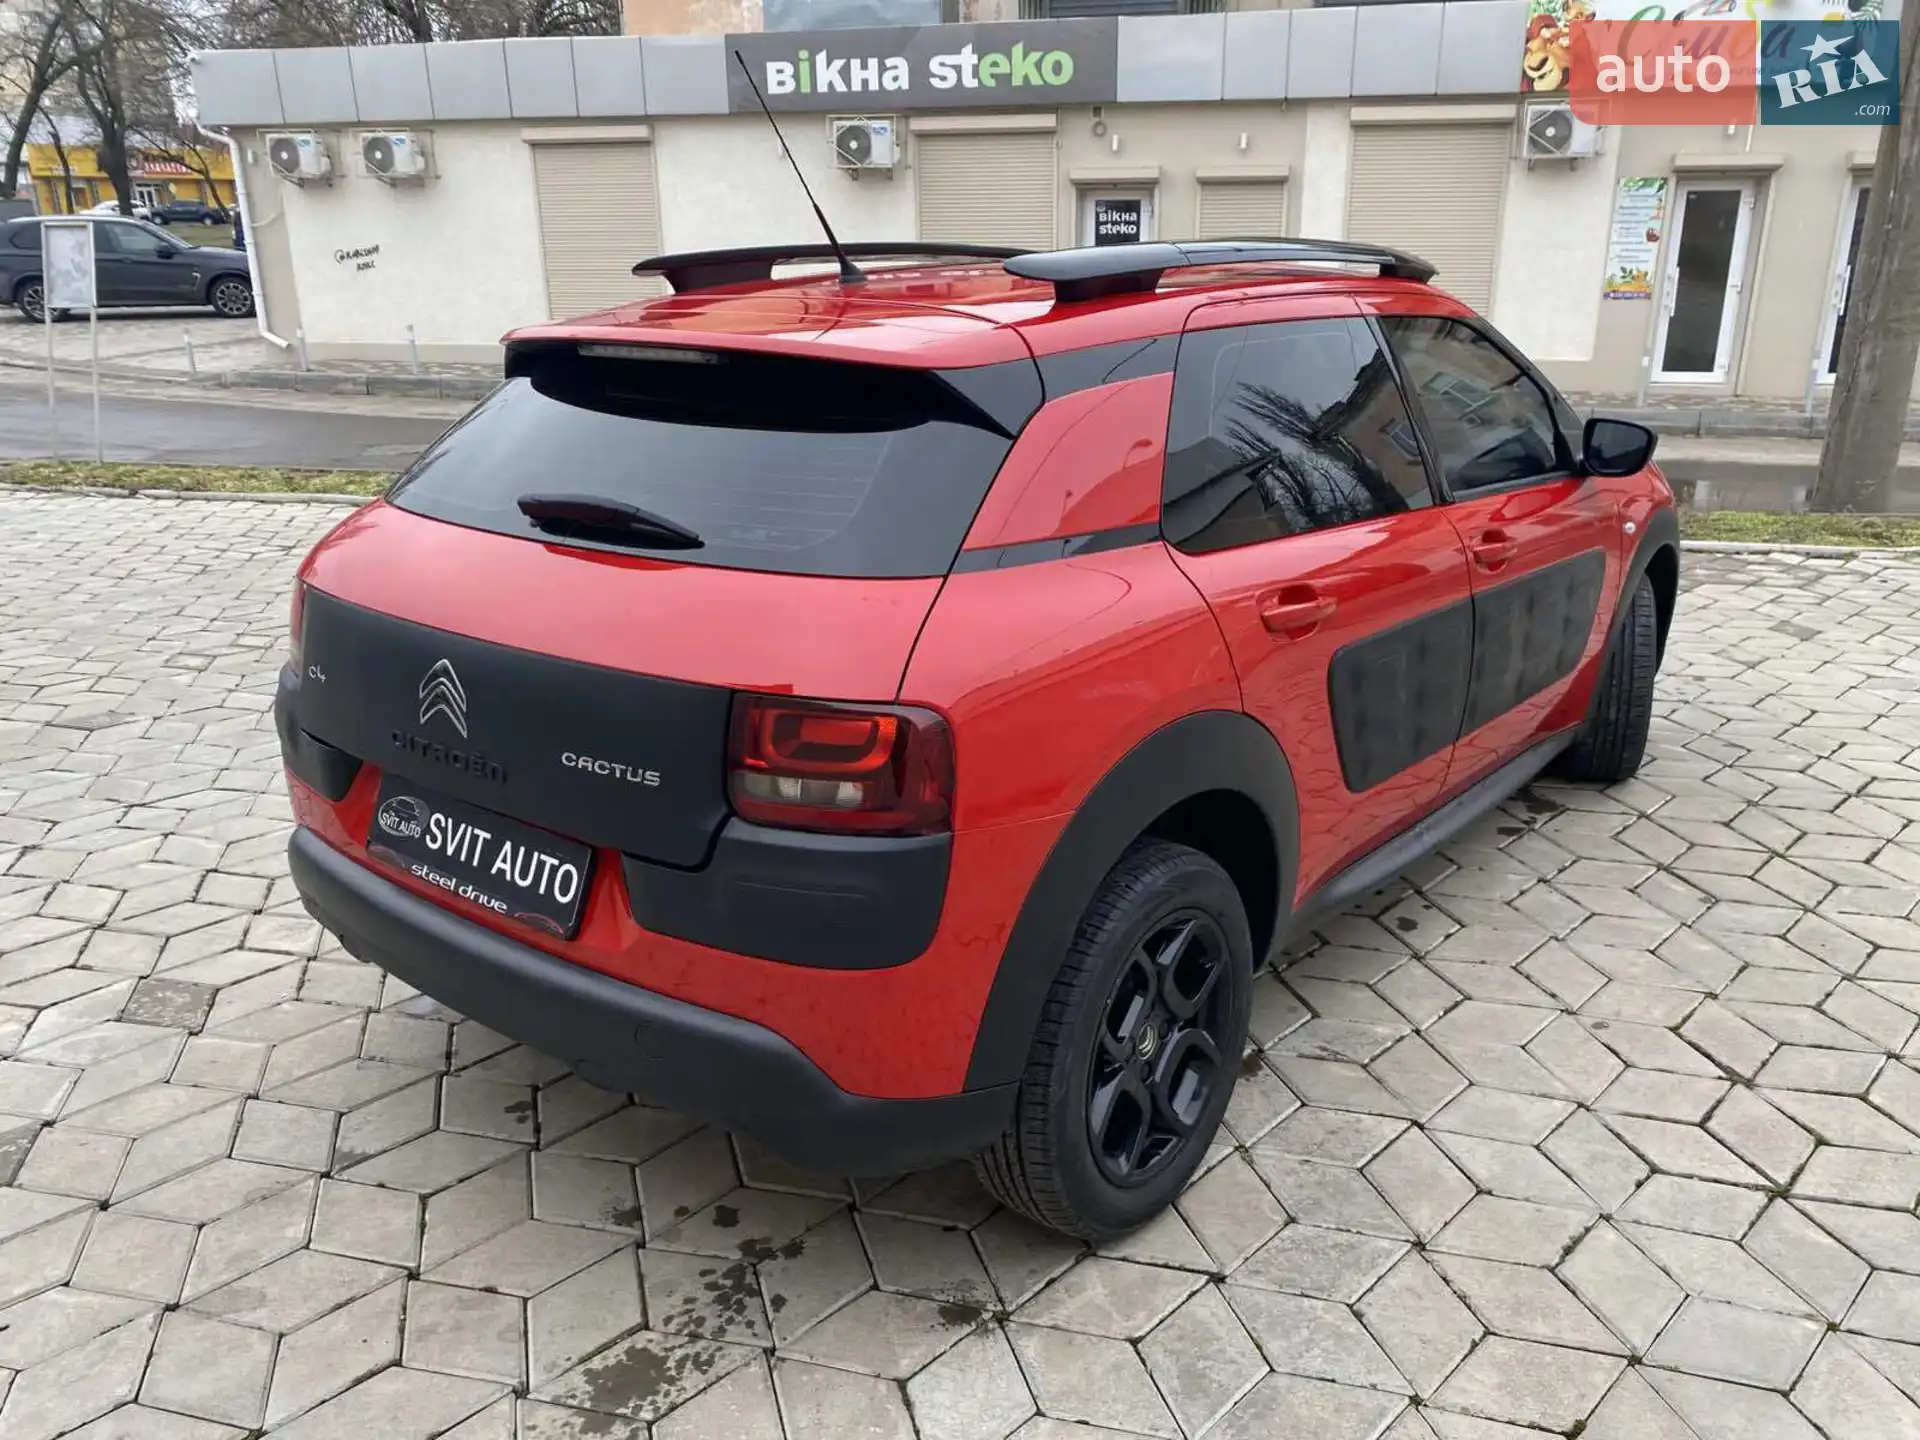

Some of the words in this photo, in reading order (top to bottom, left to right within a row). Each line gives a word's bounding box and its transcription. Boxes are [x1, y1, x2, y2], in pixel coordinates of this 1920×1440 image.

[929, 41, 1074, 89] steko
[1098, 222, 1138, 235] steko
[308, 665, 327, 683] C4
[561, 751, 661, 787] CACTUS
[380, 812, 400, 829] SVIT
[399, 820, 422, 839] AUTO
[425, 812, 492, 867] SVIT
[491, 840, 578, 904] AUTO
[411, 863, 457, 891] steel
[458, 883, 508, 914] drive
